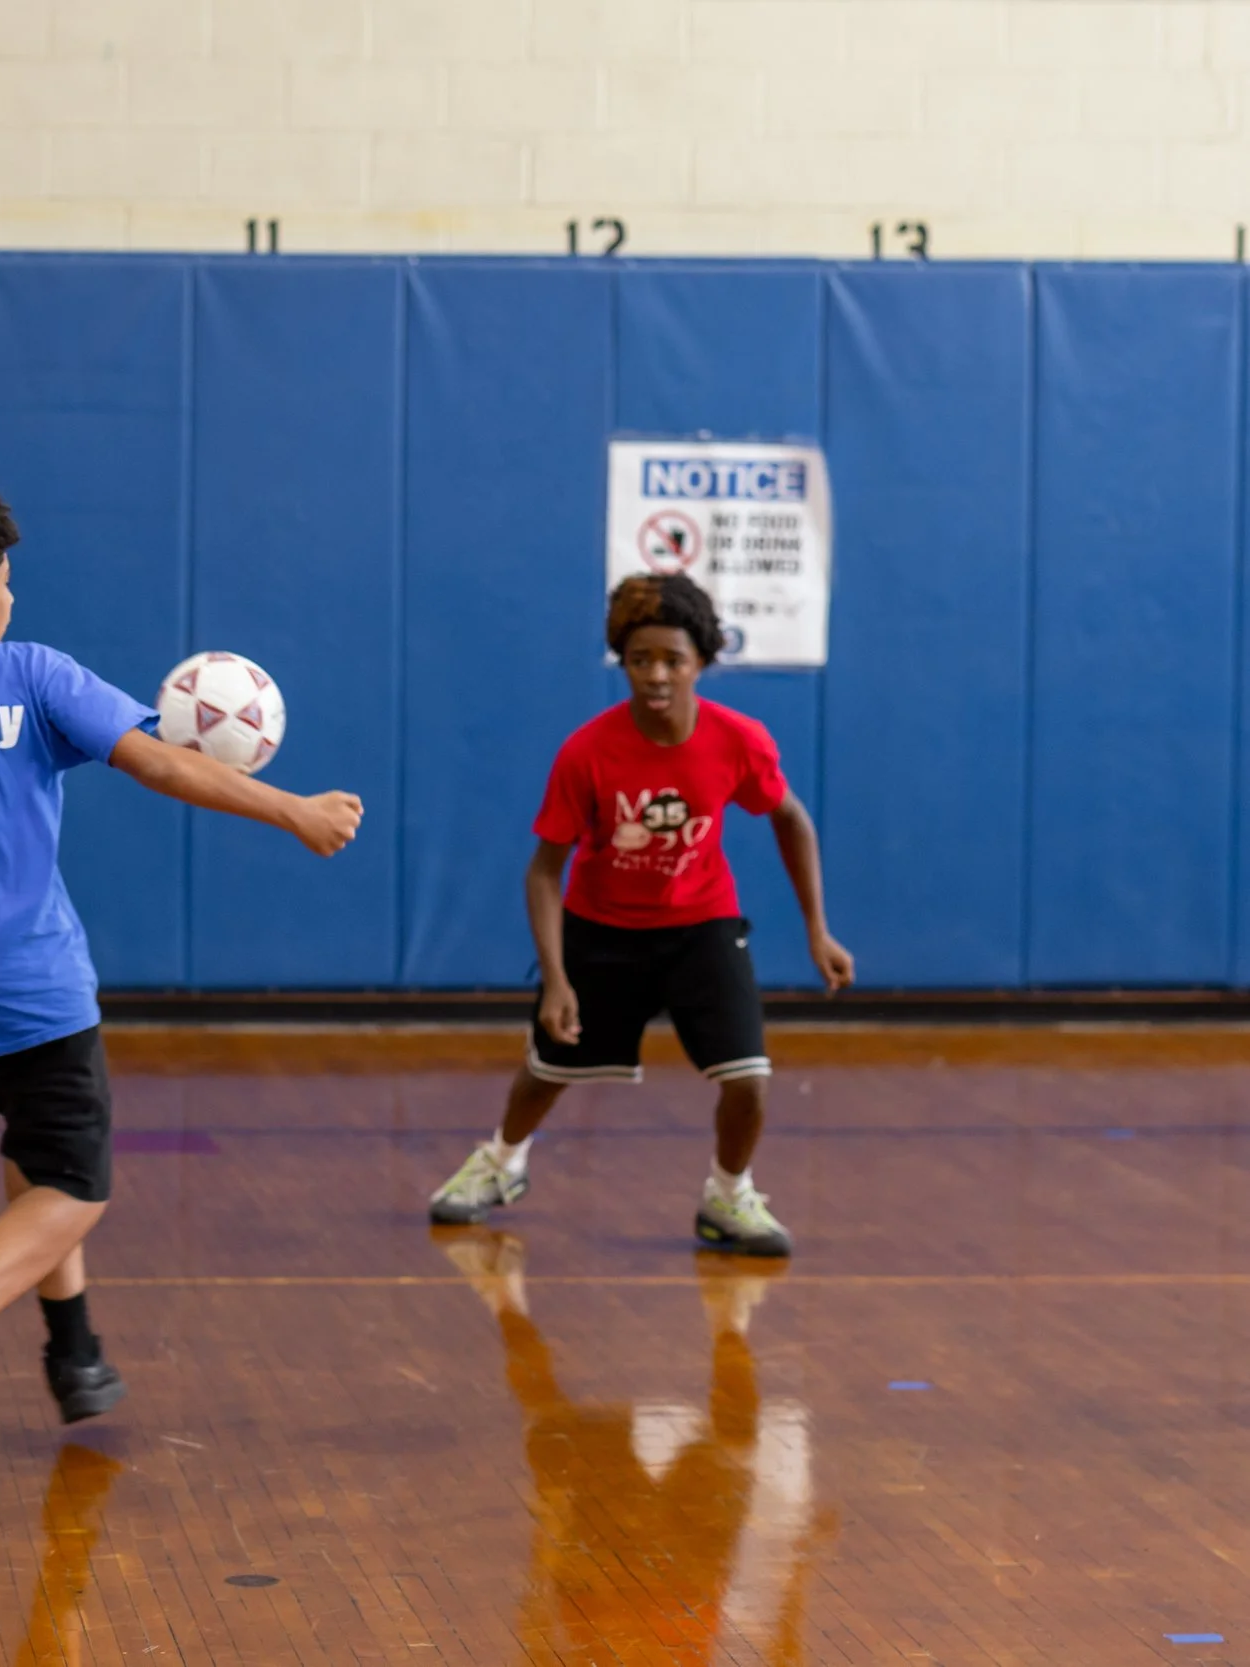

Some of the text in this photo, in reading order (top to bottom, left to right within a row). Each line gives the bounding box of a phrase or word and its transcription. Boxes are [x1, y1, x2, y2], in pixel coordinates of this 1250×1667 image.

[246, 217, 278, 254] 11
[566, 217, 625, 256] 12
[871, 220, 928, 260] 13
[649, 461, 804, 499] NOTICE
[643, 801, 688, 829] 35
